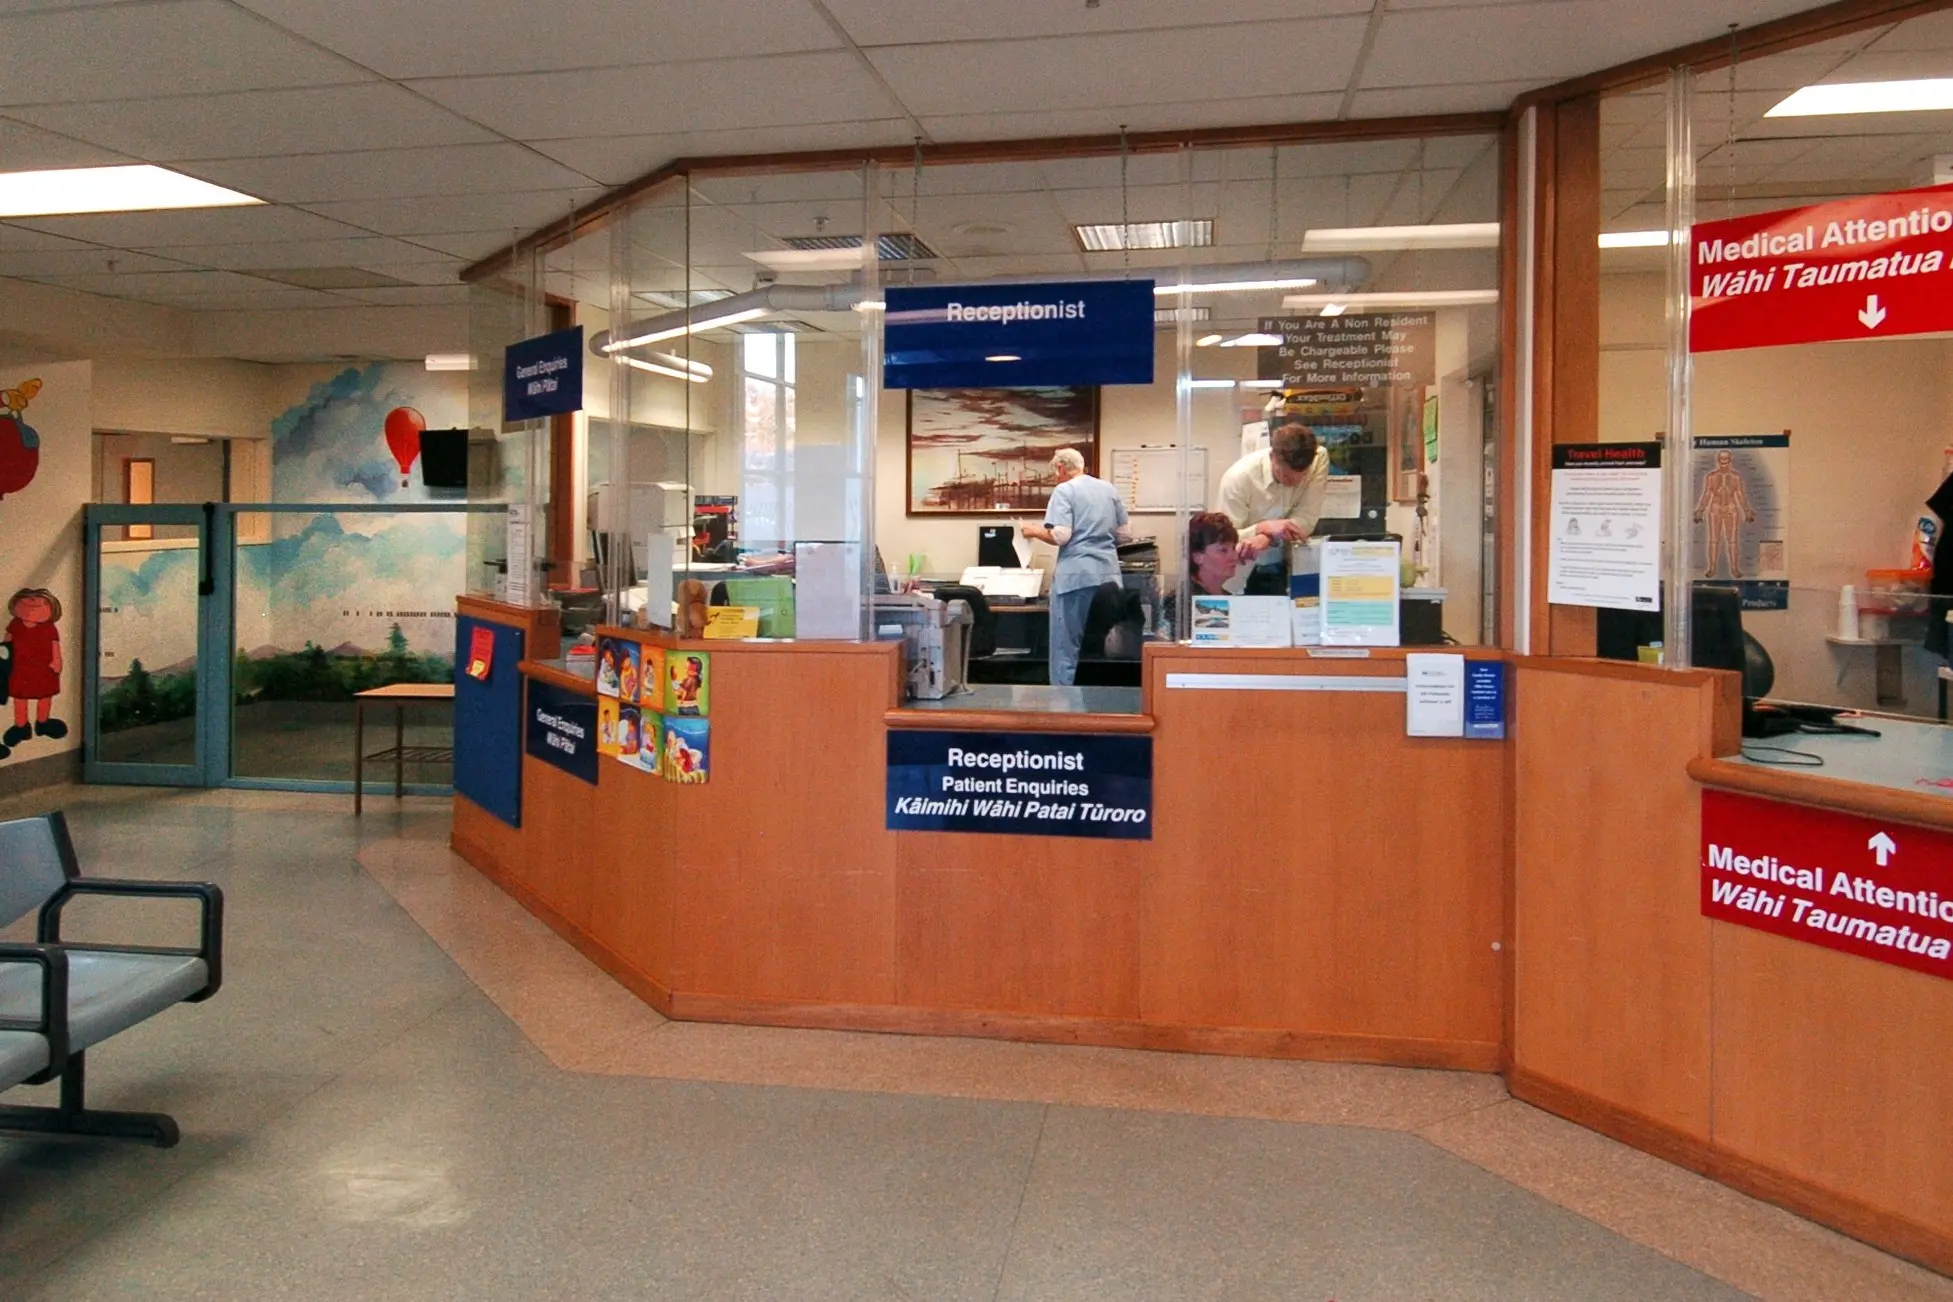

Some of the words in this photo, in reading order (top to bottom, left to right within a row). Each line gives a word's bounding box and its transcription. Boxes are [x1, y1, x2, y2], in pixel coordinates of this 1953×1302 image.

[1698, 225, 1814, 265] Medical
[1701, 267, 1775, 299] Wāhi
[1783, 250, 1944, 289] Taumatua
[946, 300, 1086, 325] Receptionist
[1264, 320, 1274, 331] If
[1278, 320, 1300, 331] You
[1305, 320, 1326, 330] Are
[1330, 319, 1340, 329] A
[1345, 318, 1369, 329] Non
[1374, 316, 1428, 328] Resident
[1286, 333, 1311, 343] Your
[1317, 331, 1376, 343] Treatment
[1382, 330, 1407, 342] May
[1279, 347, 1294, 357] Be
[1301, 344, 1369, 358] Chargeable
[1374, 343, 1415, 354] Please
[1293, 360, 1318, 370] See
[1323, 357, 1399, 370] Receptionist
[1282, 374, 1302, 384] For
[1307, 373, 1337, 383] More
[1342, 371, 1412, 383] Information
[1604, 447, 1646, 460] Health
[947, 748, 1085, 773] Receptionist
[942, 776, 1003, 794] Patient
[1005, 778, 1090, 799] Enquiries
[973, 799, 1021, 819] Wāhi
[1024, 801, 1074, 821] Patai
[1079, 804, 1147, 824] Tūroro
[1707, 843, 1824, 892] Medical
[1711, 878, 1786, 918] Wāhi
[1792, 898, 1952, 960] Taumatua
